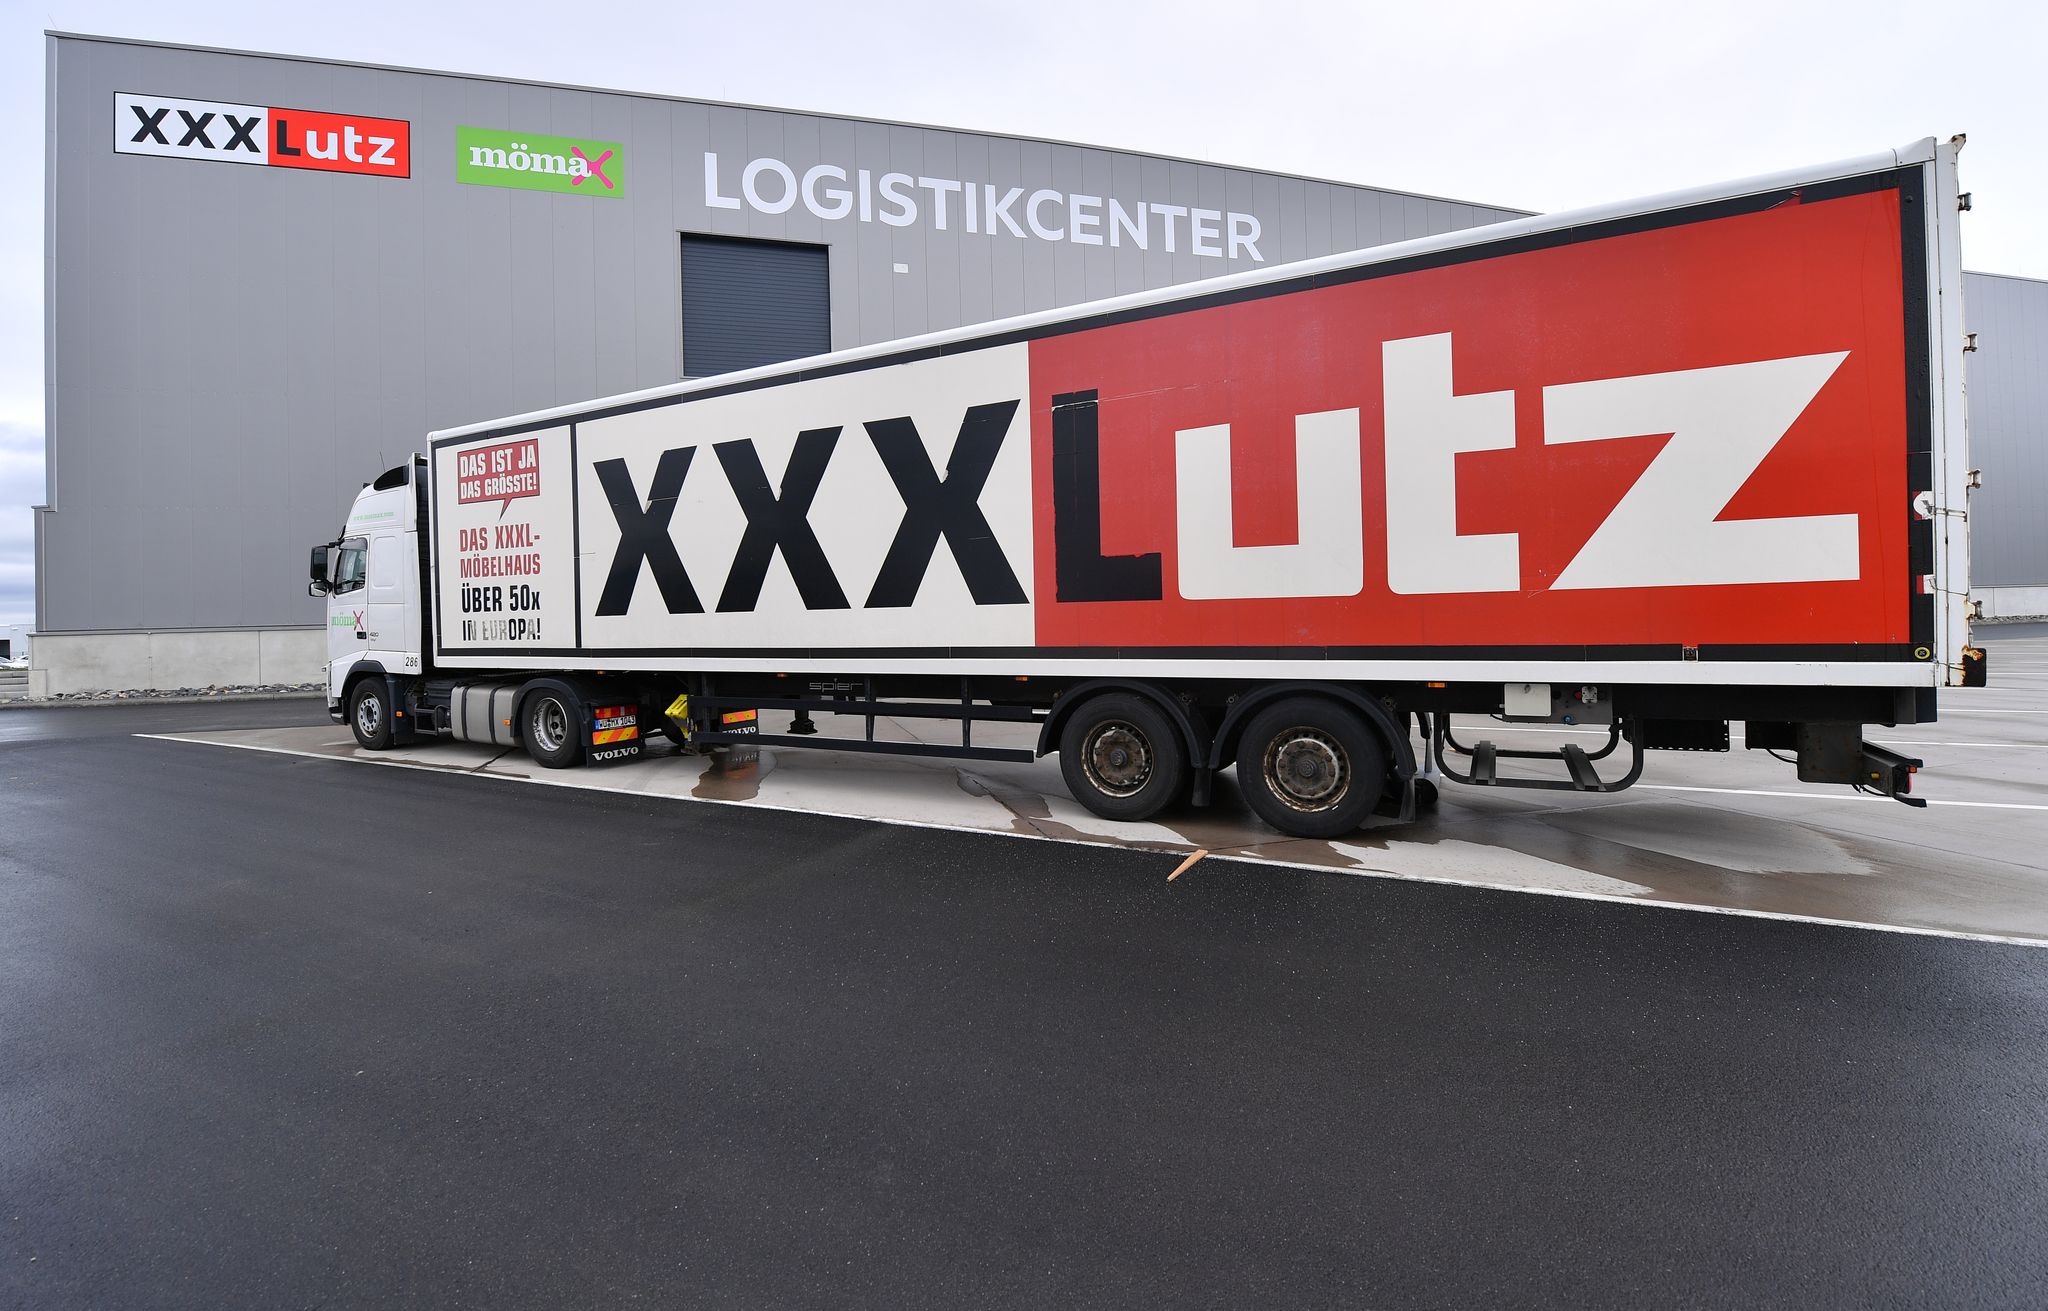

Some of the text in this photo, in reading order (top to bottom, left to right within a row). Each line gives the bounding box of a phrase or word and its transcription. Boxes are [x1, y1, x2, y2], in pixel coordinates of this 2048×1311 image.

[704, 151, 1264, 262] LOGISTIKCENTER
[460, 444, 537, 477] DAS IST JA
[460, 473, 537, 499] DAS GRÖSSTE!
[459, 523, 540, 552] DAS XXXL-
[460, 553, 541, 578] MÖBELHAUS
[461, 583, 502, 613] ÜBER
[462, 617, 541, 641] IN EUROPA!
[405, 656, 418, 667] 286
[592, 747, 639, 760] VOLVO
